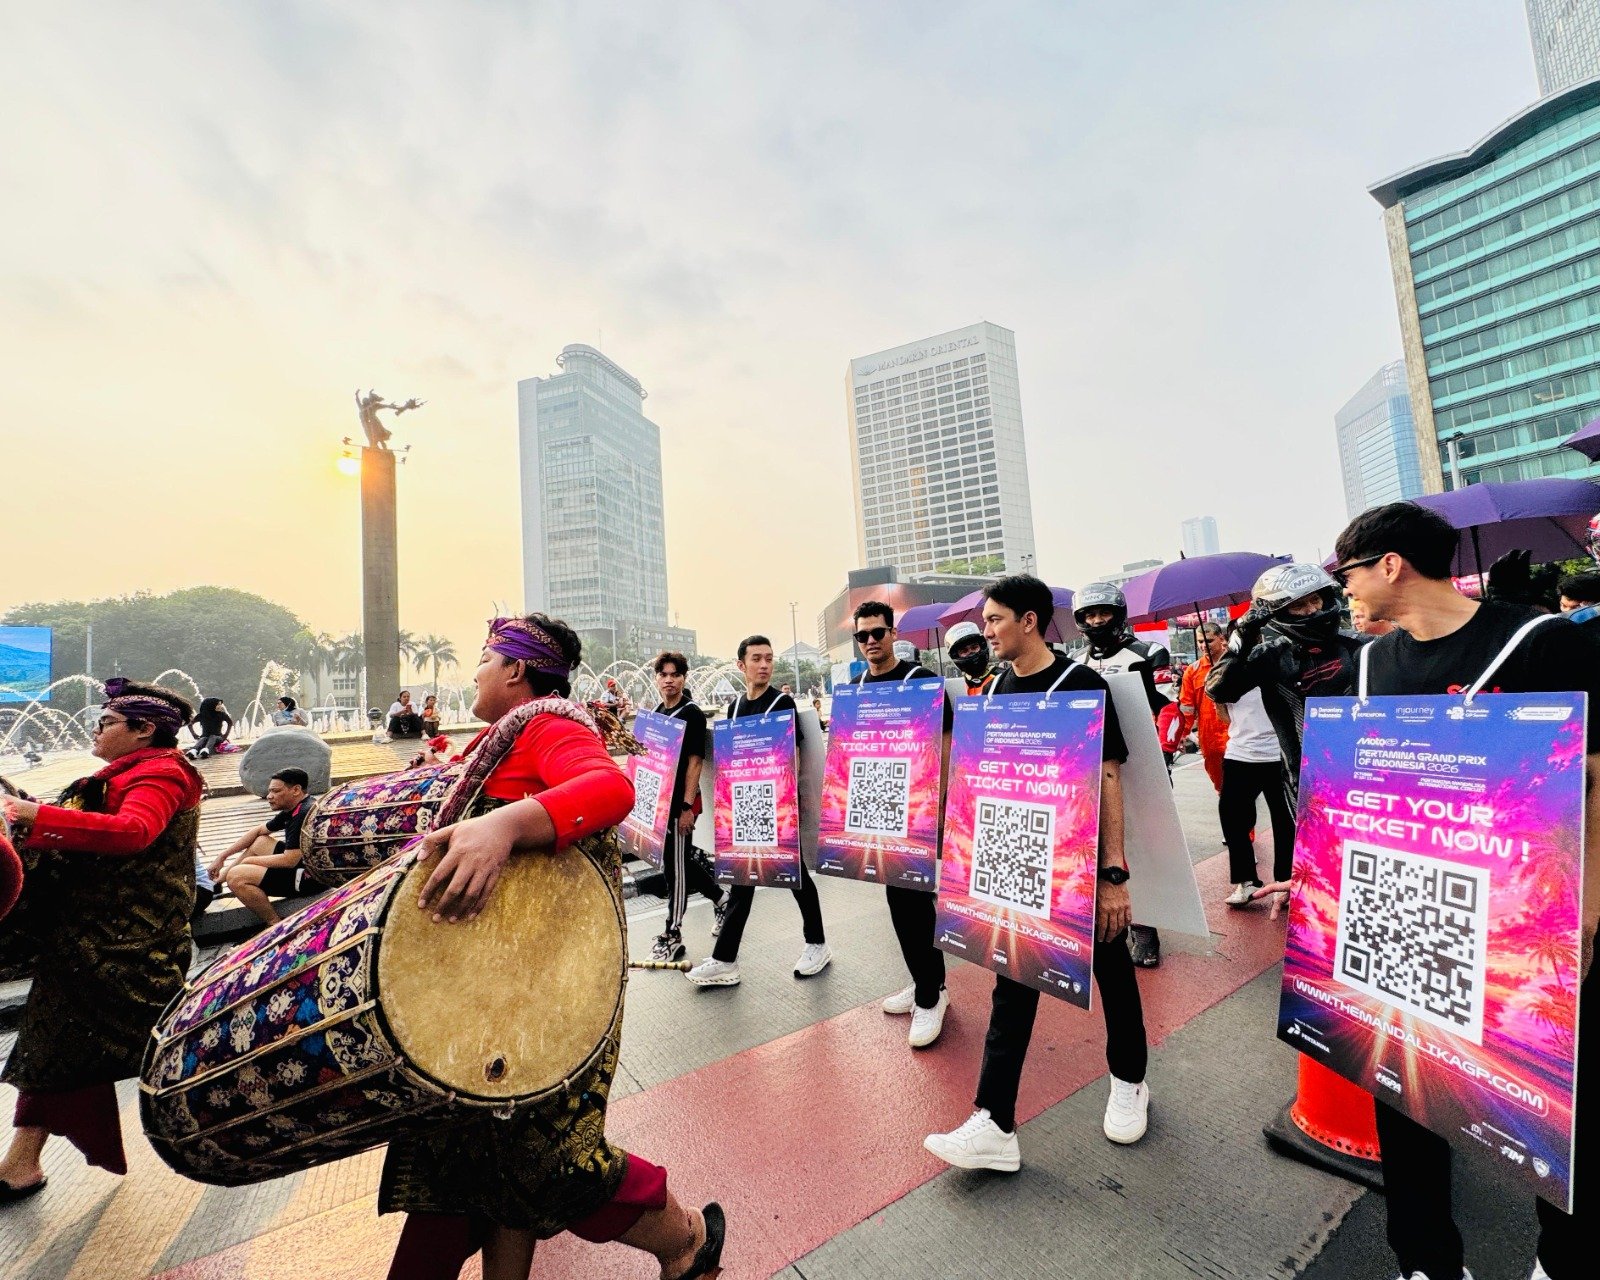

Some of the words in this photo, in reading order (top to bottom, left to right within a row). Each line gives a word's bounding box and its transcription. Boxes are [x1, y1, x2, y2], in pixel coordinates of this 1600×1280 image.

[879, 350, 927, 371] MANDARIN
[931, 336, 979, 356] ORIENTAL
[1293, 574, 1315, 588] NHK
[1396, 707, 1435, 715] injourney
[852, 730, 877, 740] GET
[879, 730, 914, 740] YOUR
[1357, 737, 1399, 747] MotoGP
[840, 742, 887, 752] TICKET
[889, 742, 919, 752] NOW
[731, 758, 749, 768] GET
[750, 756, 775, 765] YOUR
[1358, 758, 1371, 766] OF
[1372, 758, 1426, 771] INDONESIA
[1427, 762, 1459, 773] 2026
[1359, 749, 1416, 760] PERTAMINA
[1417, 752, 1457, 763] GRAND
[1458, 755, 1487, 766] PRIX
[722, 767, 757, 778] TICKET
[758, 766, 782, 776] NOW
[979, 760, 1010, 775] GET
[1013, 762, 1059, 778] YOUR
[965, 774, 1025, 792] TICKET
[1025, 779, 1068, 797] NOW
[1071, 784, 1076, 798] !
[1347, 790, 1400, 812] GET
[1406, 797, 1494, 828] YOUR
[1324, 807, 1426, 841] TICKET
[1431, 826, 1514, 859] NOW
[1521, 841, 1530, 862] !
[825, 837, 928, 856] WWW.THEMANDALIKAGP.COM
[945, 901, 1079, 952] WWW.THEMANDALIKAGP.COM
[1296, 978, 1544, 1110] WWW.THEMANDALIKAGP.COM
